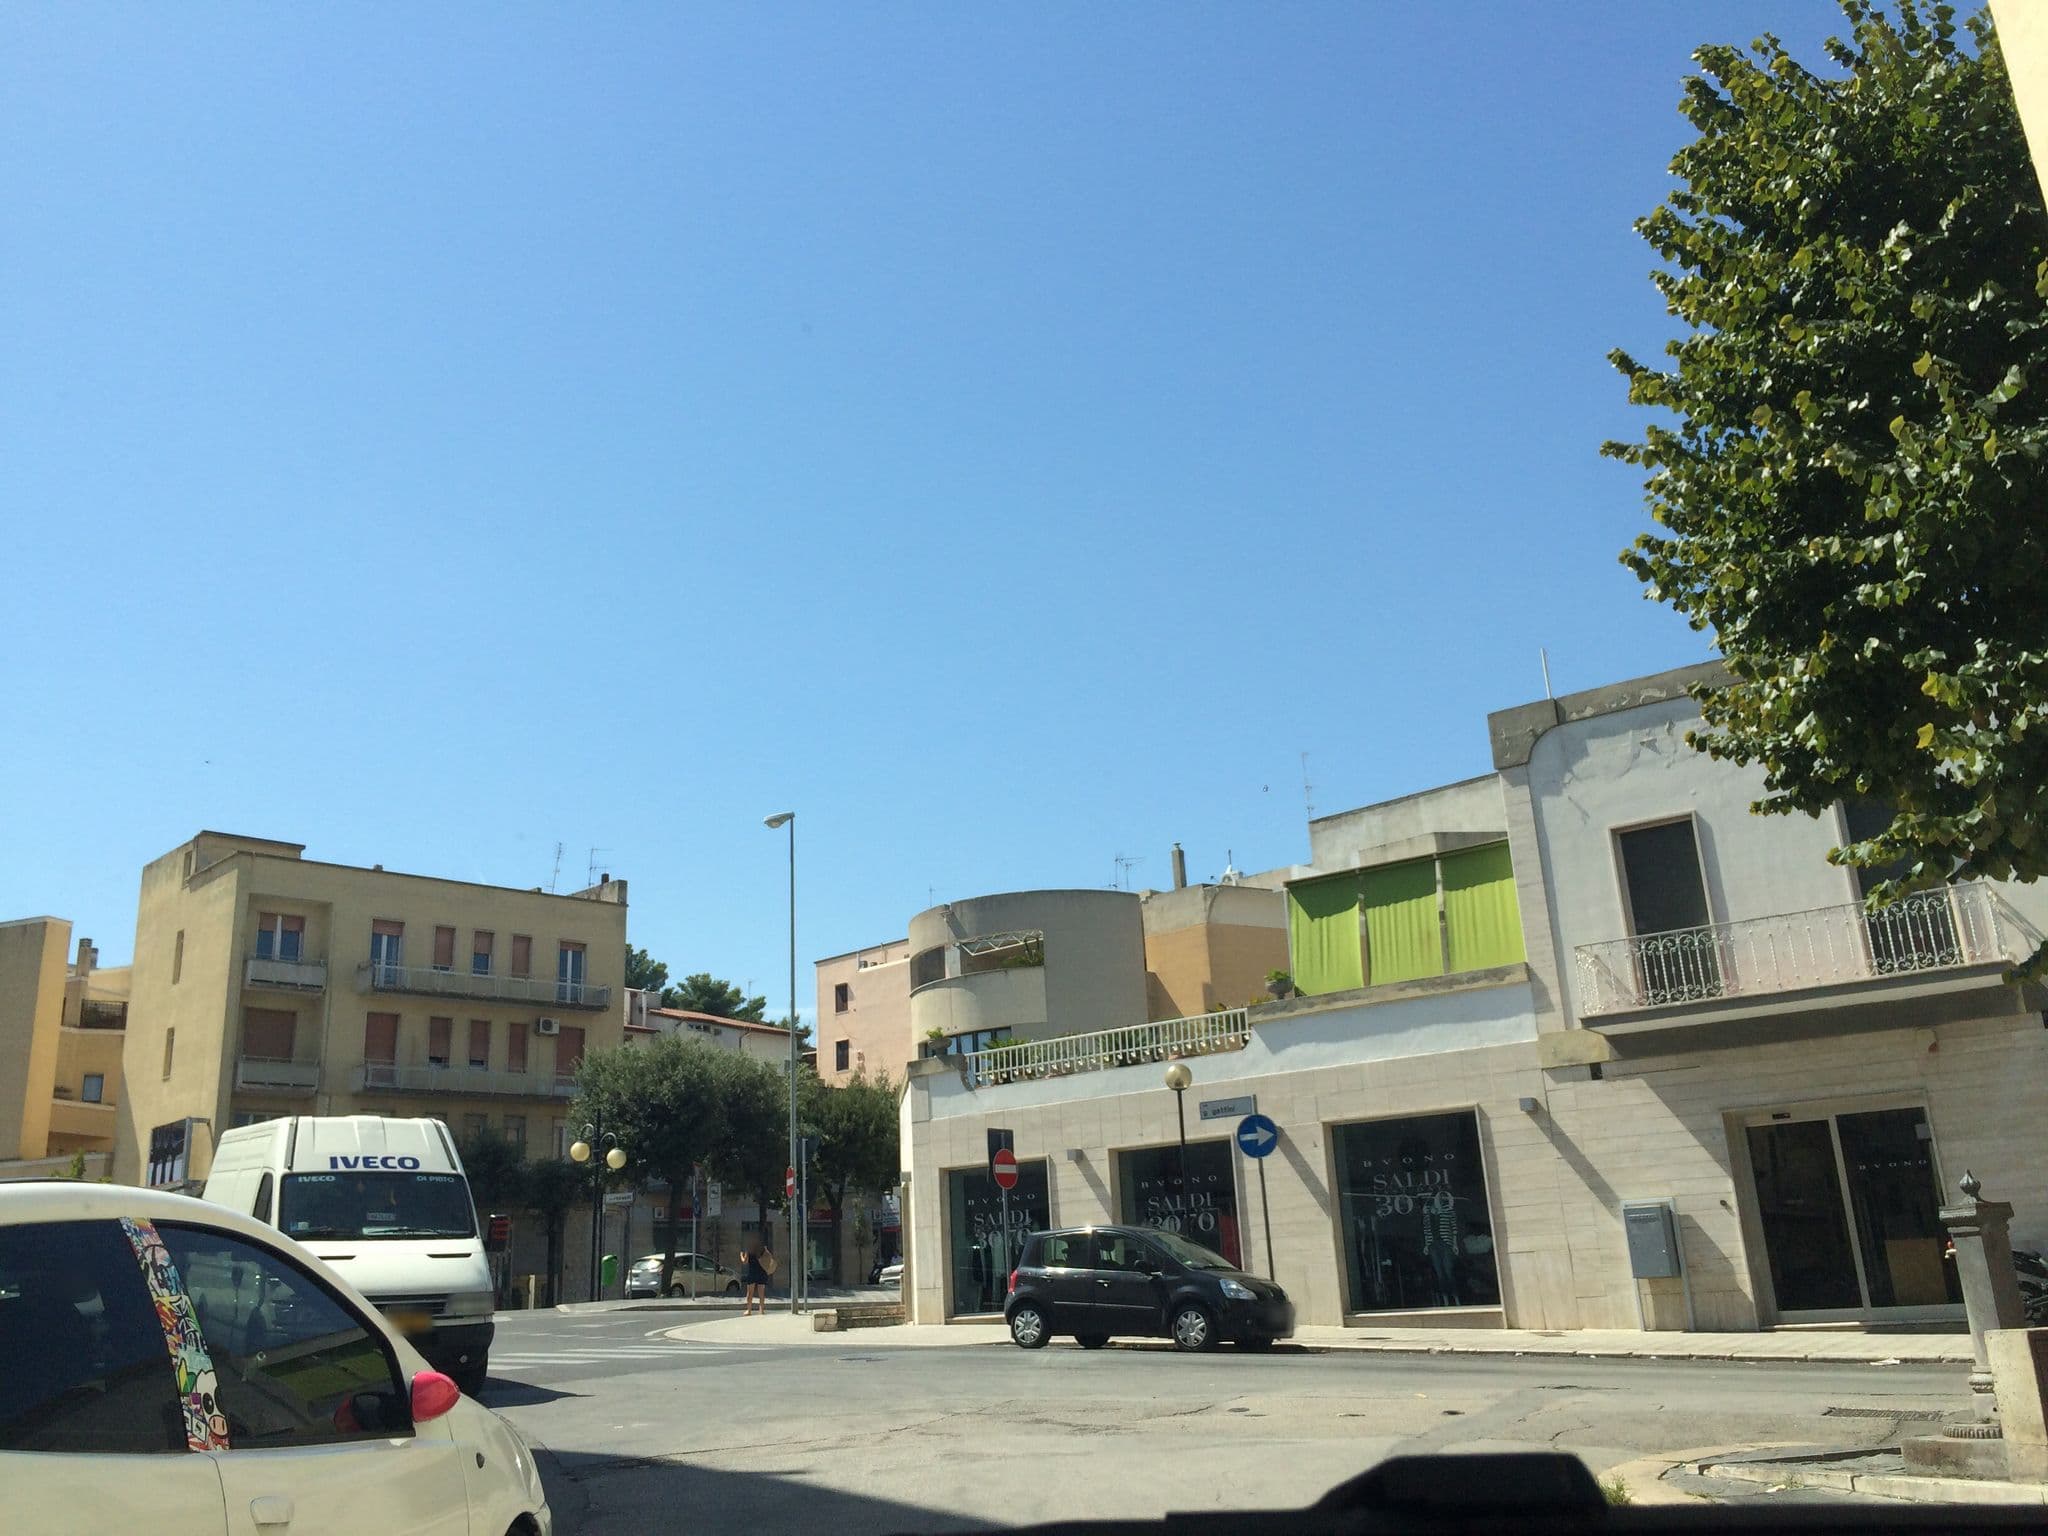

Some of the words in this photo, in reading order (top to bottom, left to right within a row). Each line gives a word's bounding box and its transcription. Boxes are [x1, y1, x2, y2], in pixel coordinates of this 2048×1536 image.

[329, 1156, 420, 1170] IVECO
[298, 1175, 336, 1183] IVECO
[1373, 1168, 1449, 1191] SALDI
[1147, 1192, 1211, 1210] SALDI
